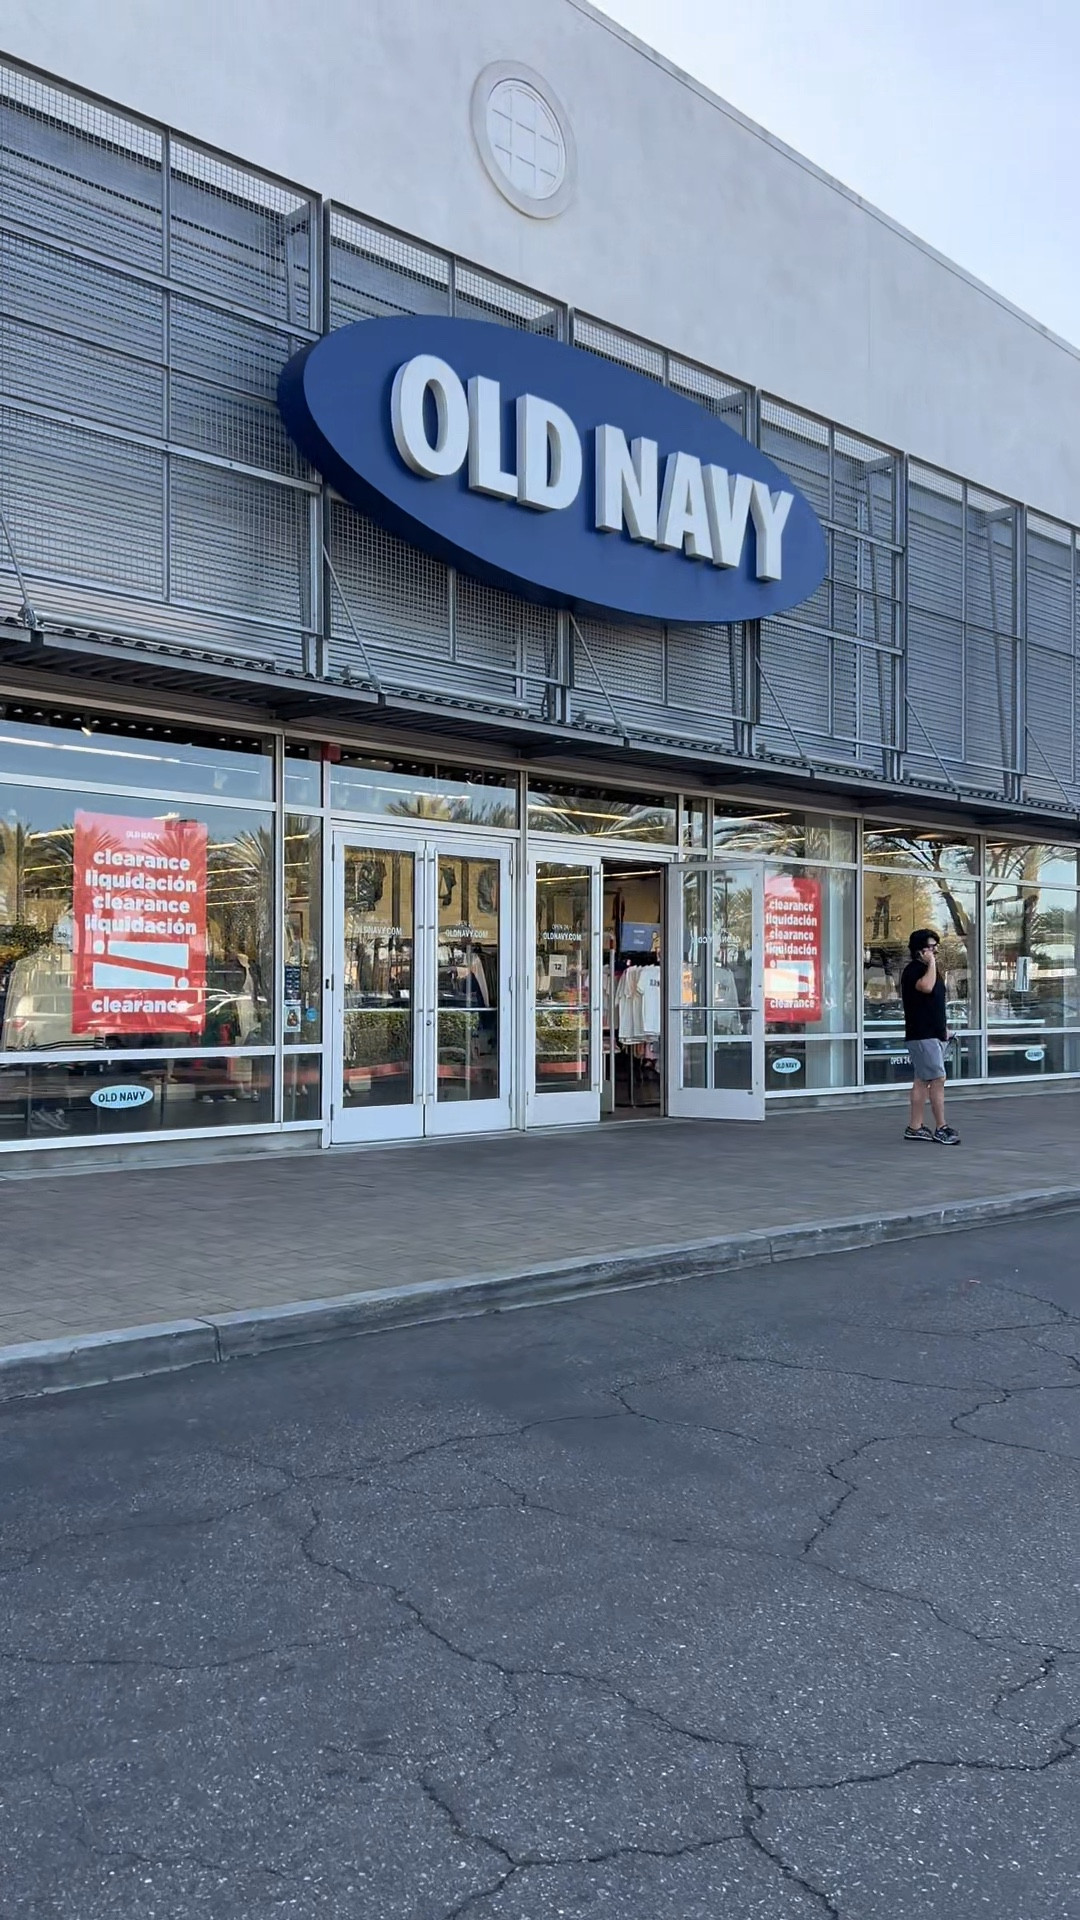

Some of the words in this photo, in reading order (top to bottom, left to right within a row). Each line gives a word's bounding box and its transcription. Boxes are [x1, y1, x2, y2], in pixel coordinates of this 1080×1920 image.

[391, 353, 582, 511] OLD
[595, 423, 795, 582] NAVY
[93, 850, 190, 871] clearance
[85, 870, 197, 893] liquidación
[92, 892, 190, 914] clearance
[769, 899, 814, 912] clearance
[84, 914, 197, 936] liquidación
[765, 914, 817, 927] liquidación
[769, 928, 814, 942] clearance
[765, 943, 817, 957] liquidación
[91, 997, 189, 1014] clearance
[770, 999, 815, 1009] clearance
[98, 1092, 118, 1103] OLD
[119, 1091, 145, 1101] NAVY
